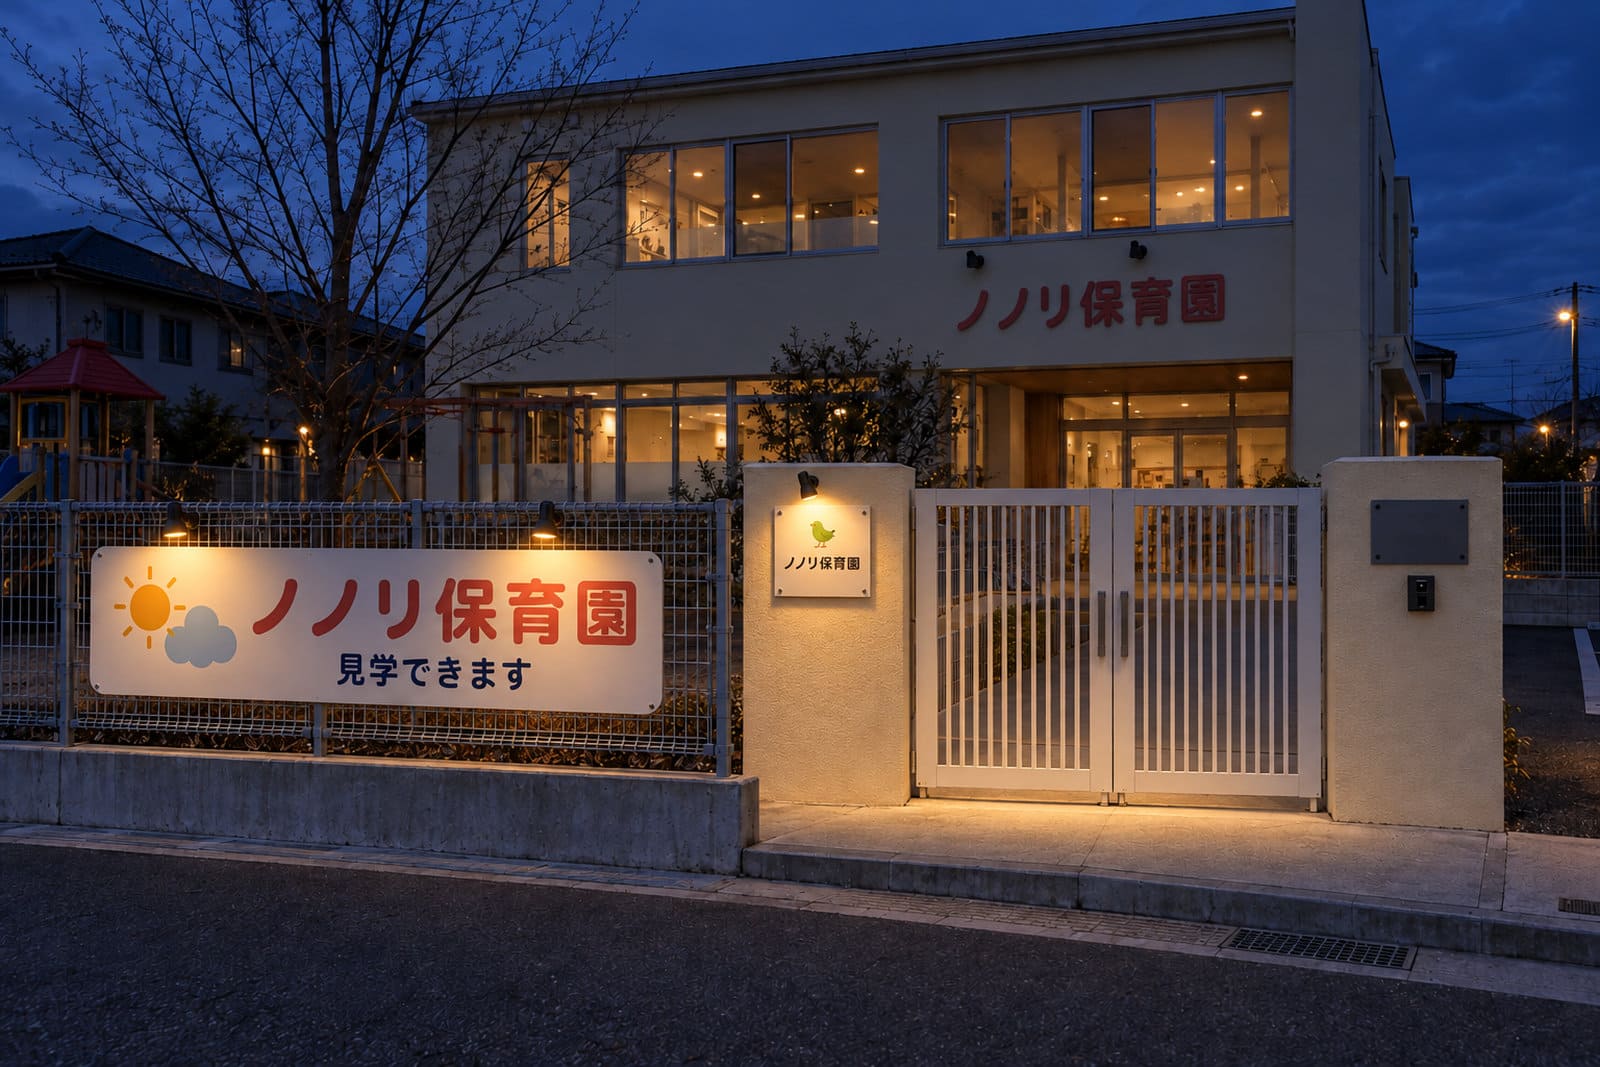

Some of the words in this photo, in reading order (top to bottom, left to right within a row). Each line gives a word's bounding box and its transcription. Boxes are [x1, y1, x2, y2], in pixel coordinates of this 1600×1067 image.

[957, 274, 1225, 331] ノノリ保育園
[784, 556, 860, 571] ノノリ保育園
[253, 578, 637, 646] ノノリ保育園
[337, 653, 532, 691] 見学できます
